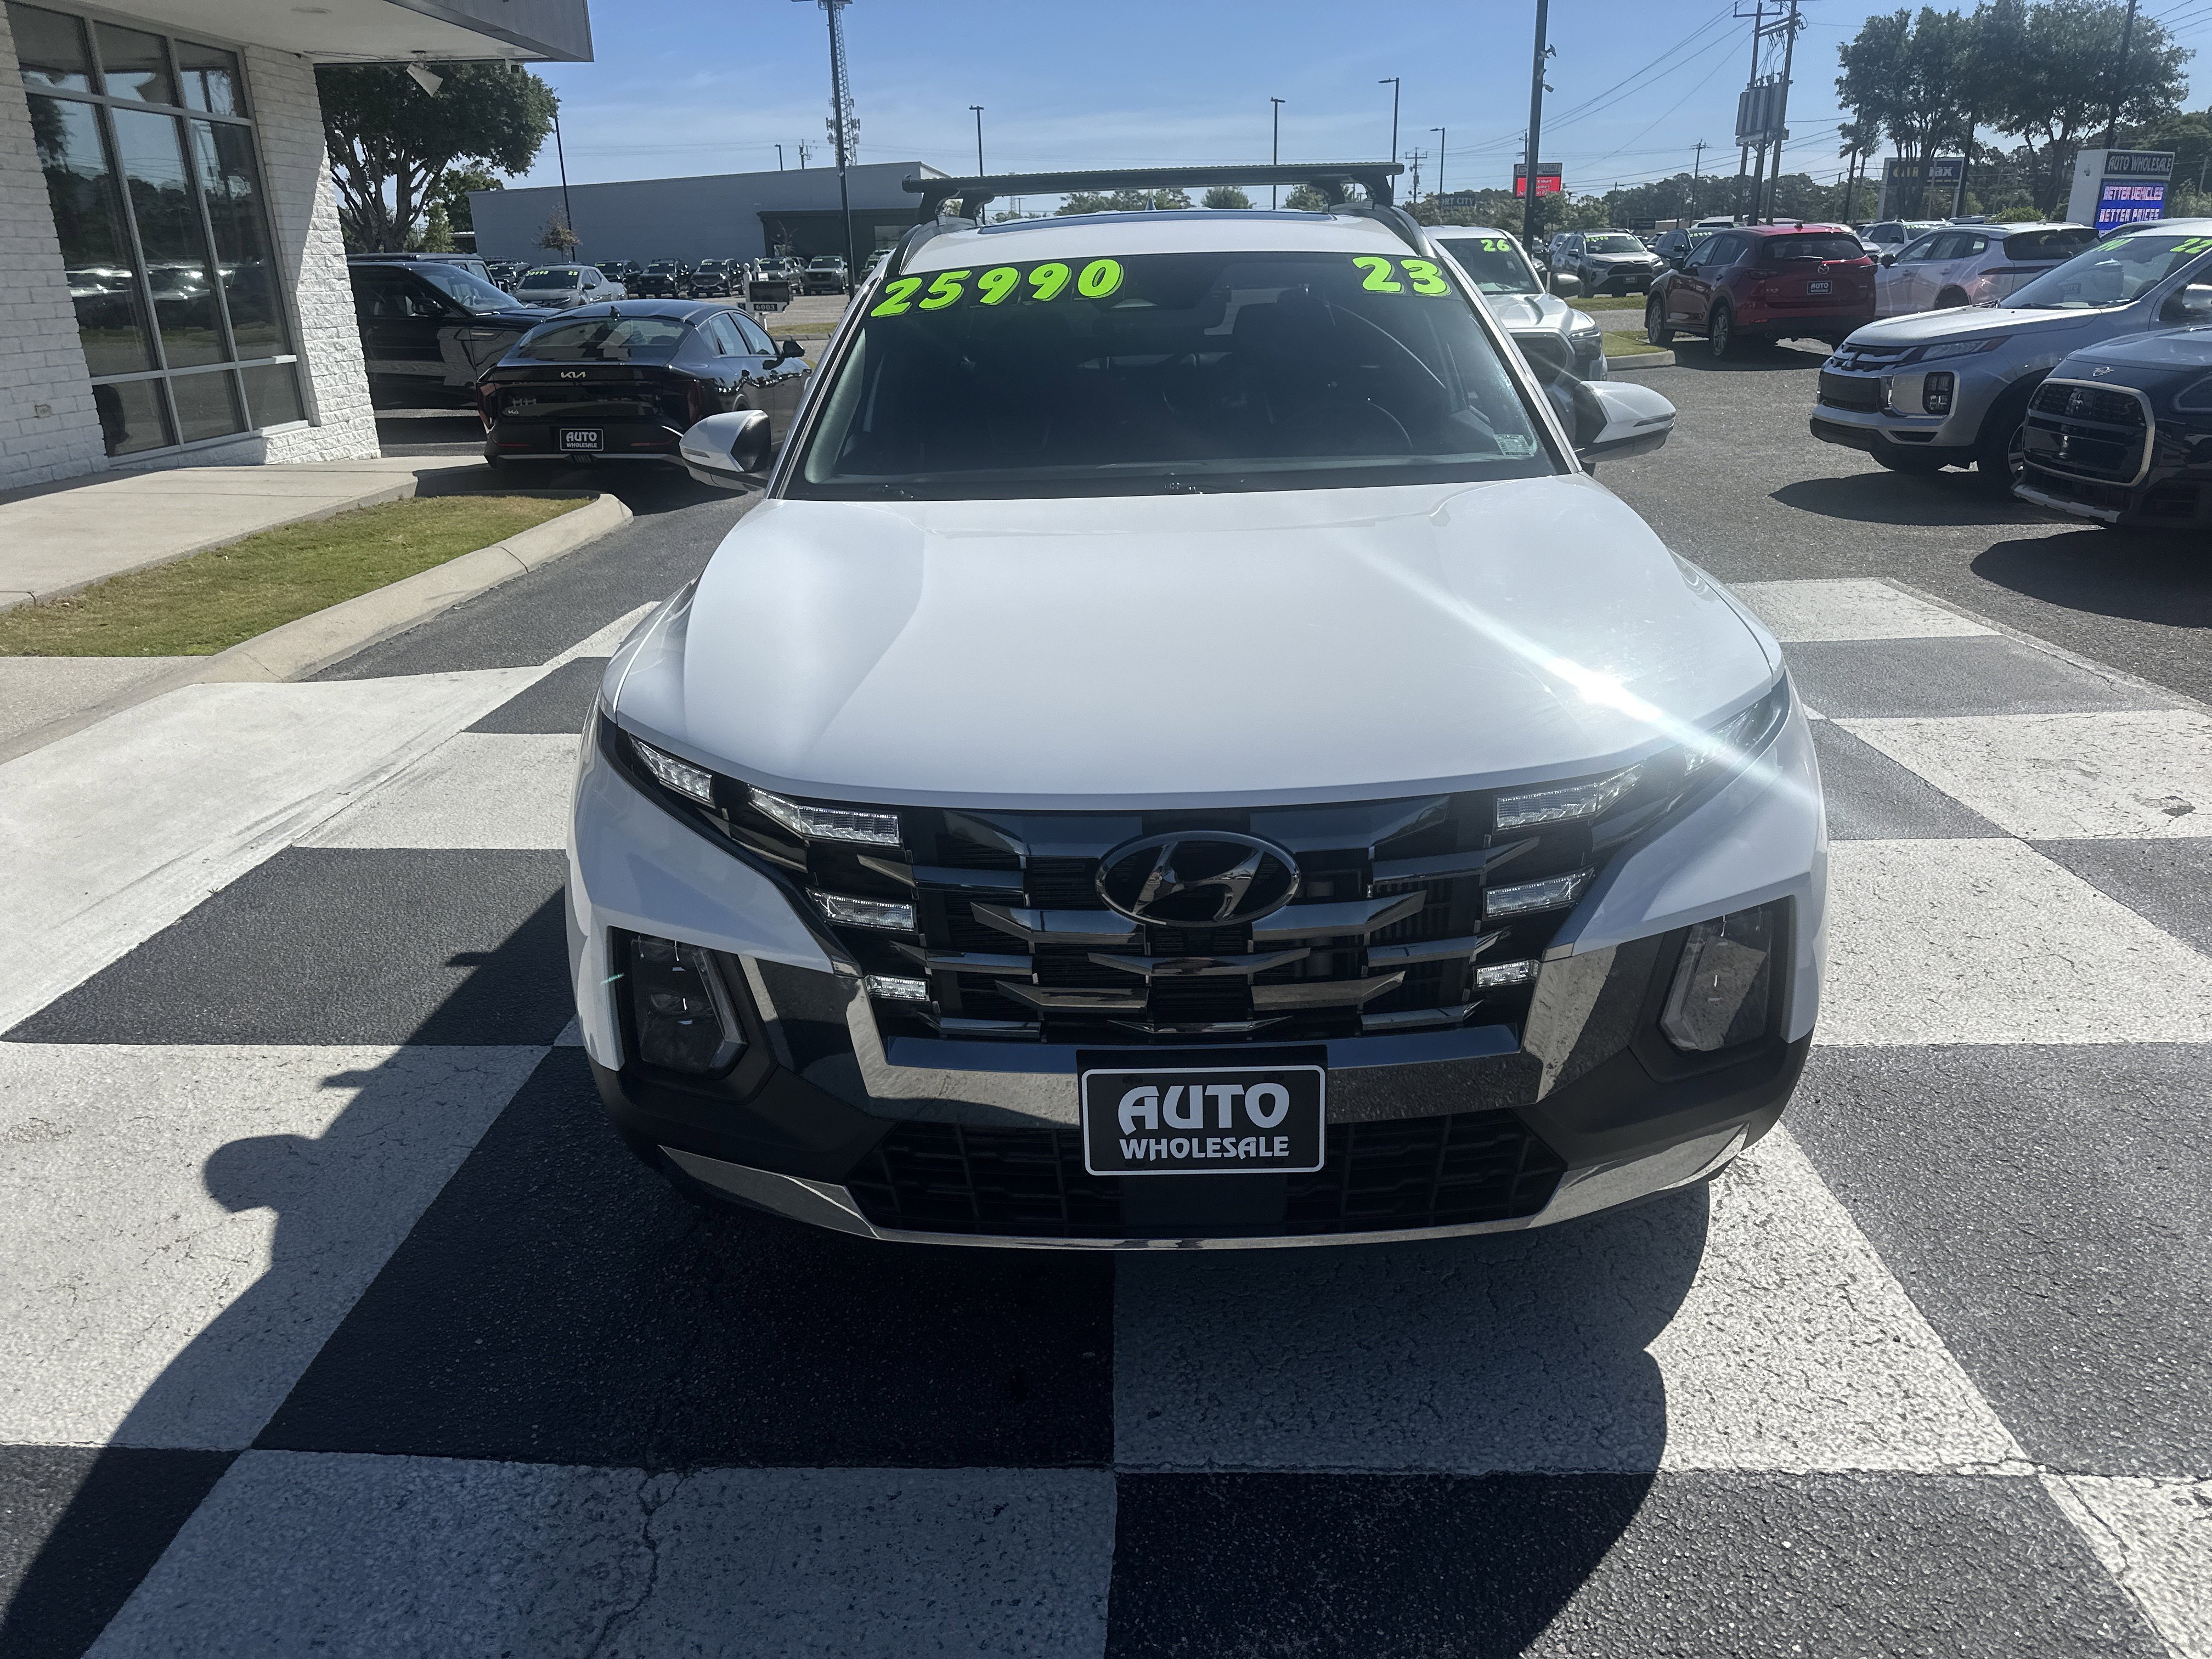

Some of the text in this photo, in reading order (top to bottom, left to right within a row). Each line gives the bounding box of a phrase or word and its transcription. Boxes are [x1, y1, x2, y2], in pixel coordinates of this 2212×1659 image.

[2108, 155, 2172, 173] AUTO WHOLESALE
[2103, 186, 2164, 200] BETTER VEHICLES
[2098, 208, 2160, 222] BETTER PRICES
[1481, 239, 1511, 252] 26
[1352, 256, 1452, 296] 23
[870, 259, 1124, 318] 25990
[566, 432, 597, 442] AUTO
[1118, 1082, 1290, 1135] AUTO
[1119, 1136, 1290, 1161] WHOLESALE
